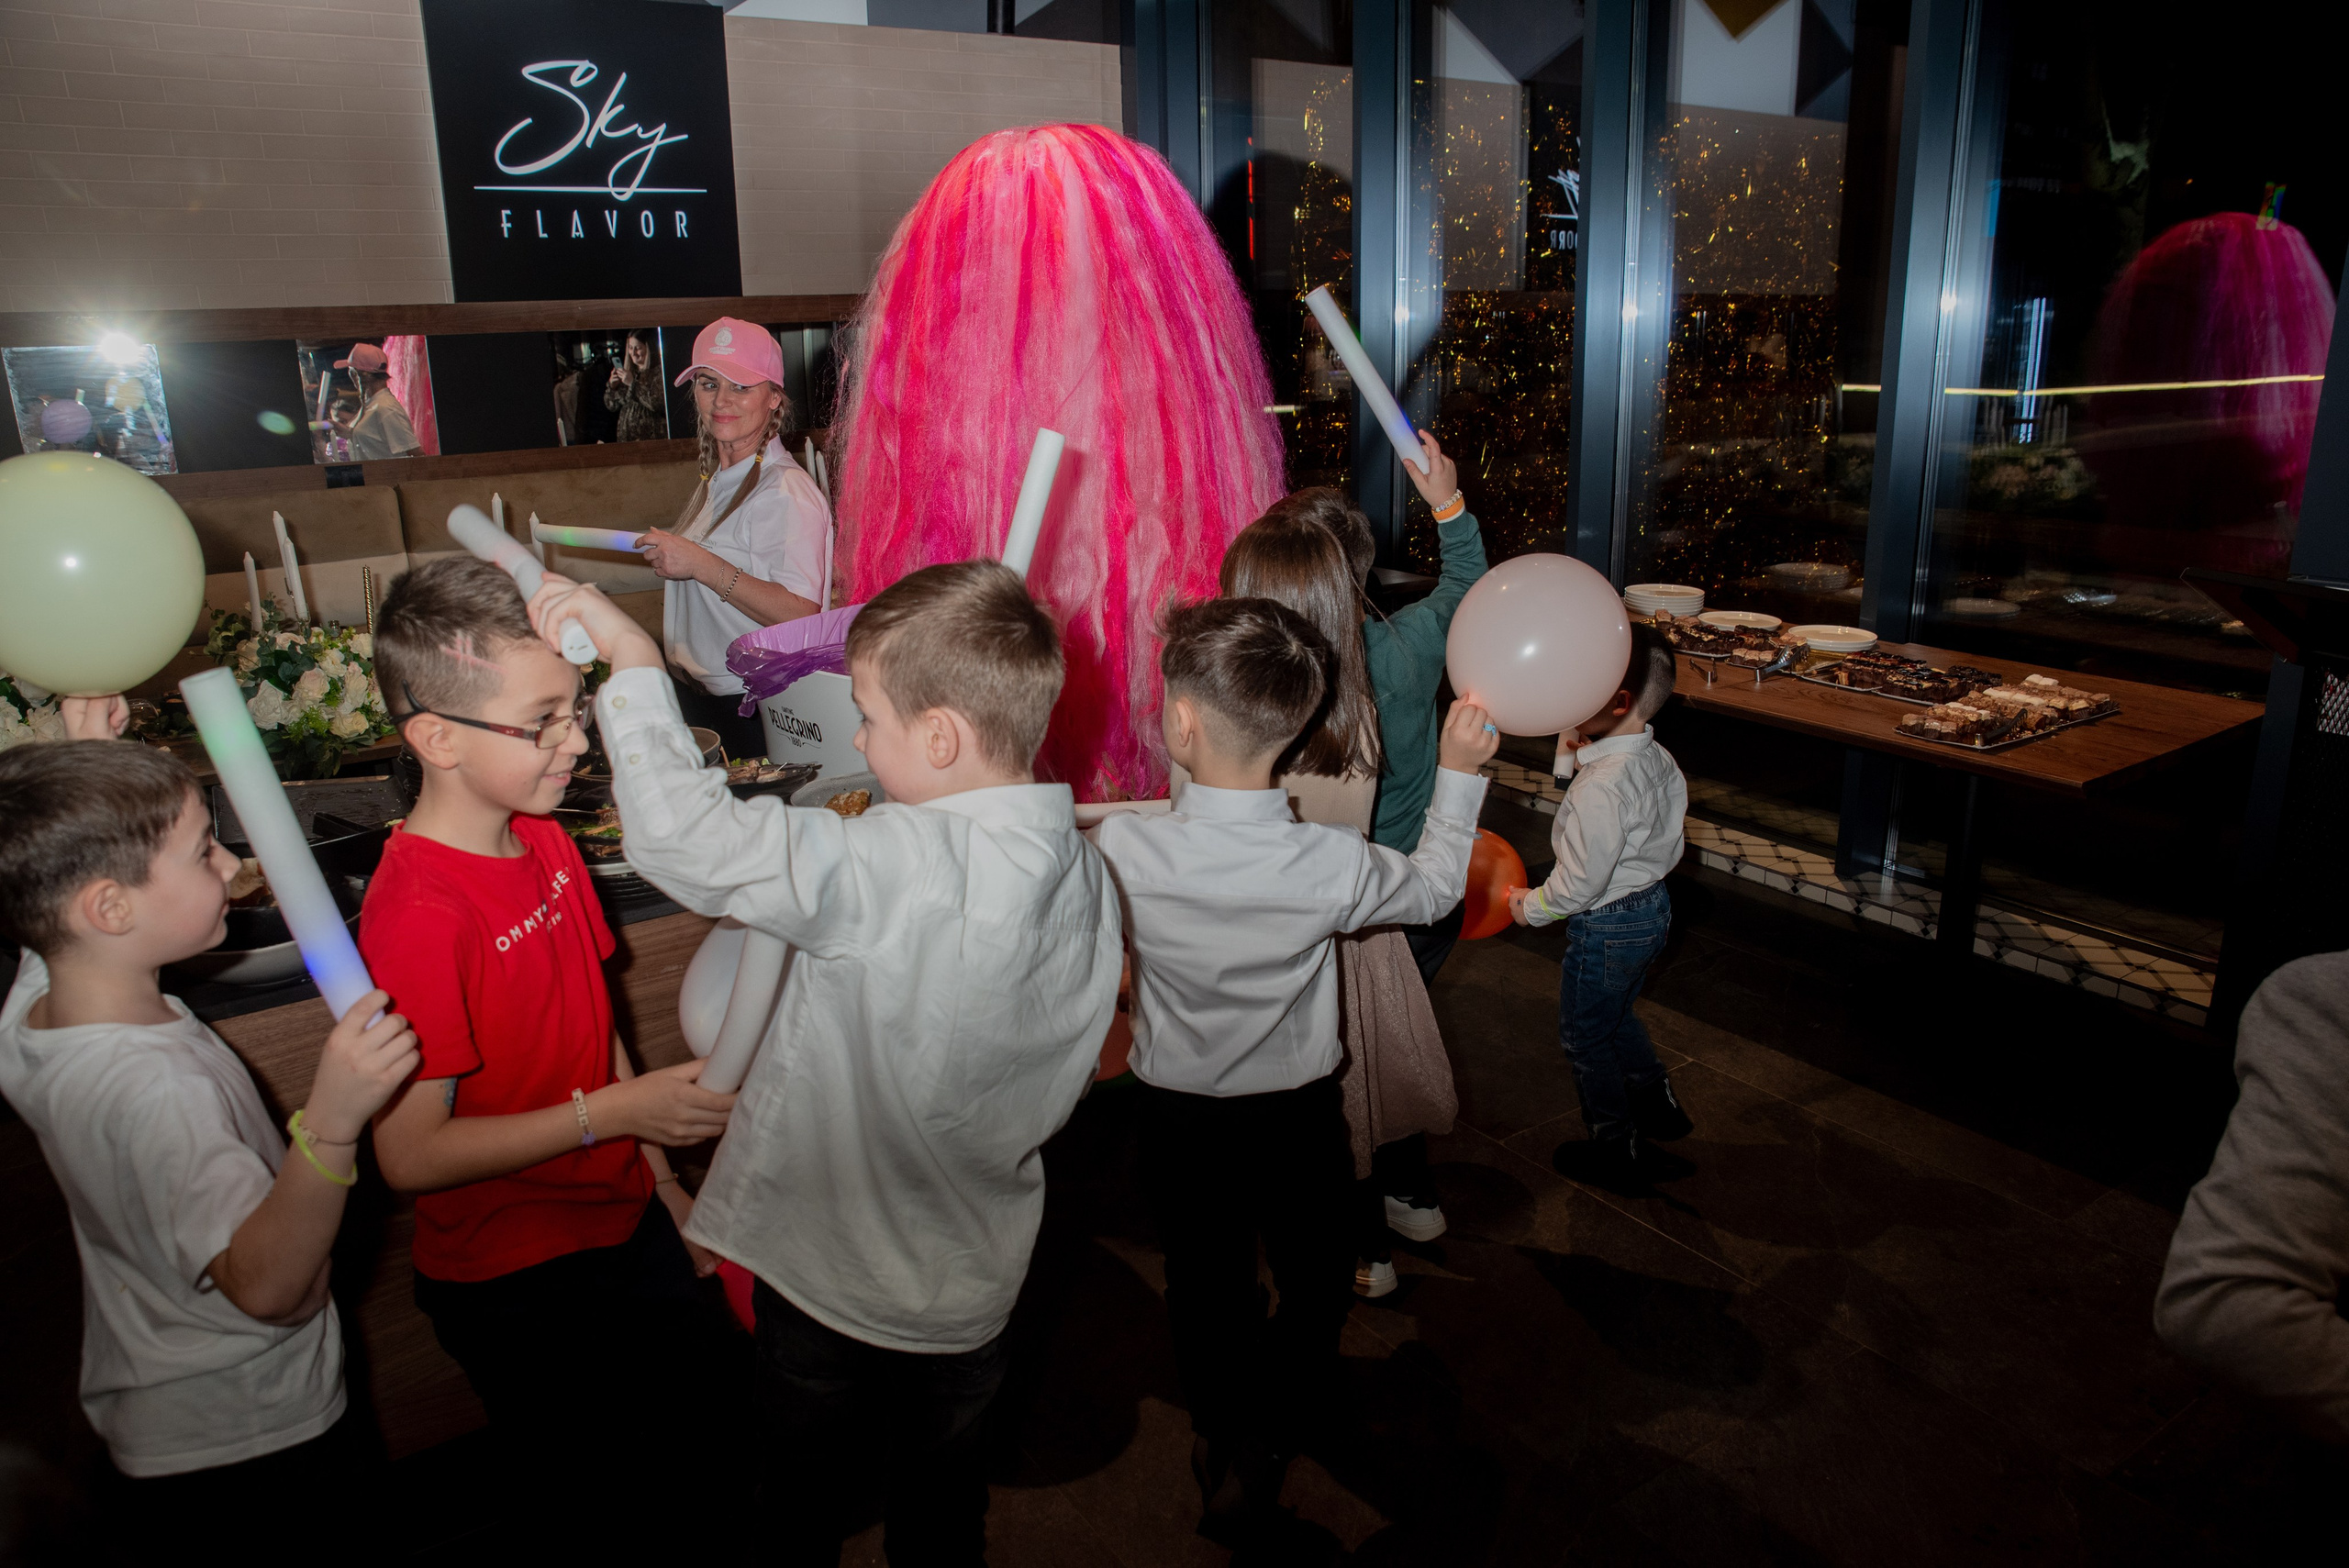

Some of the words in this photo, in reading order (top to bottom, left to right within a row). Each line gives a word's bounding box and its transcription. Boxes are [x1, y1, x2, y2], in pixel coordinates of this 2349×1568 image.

[495, 60, 688, 201] Sky
[501, 209, 688, 239] FLAVOR
[768, 706, 823, 743] PELLEGRINO
